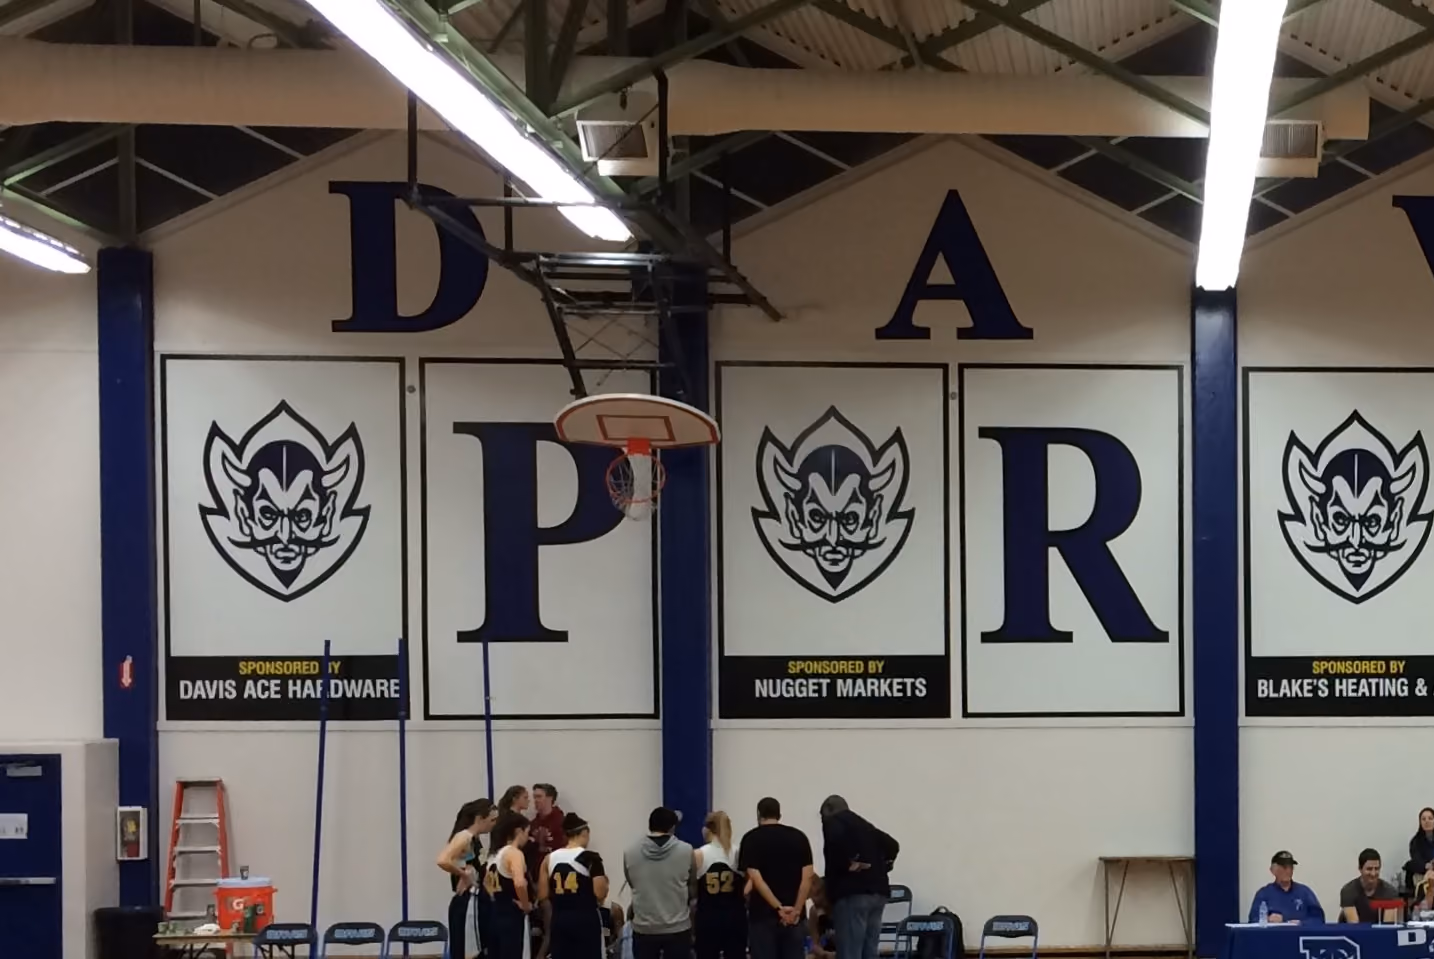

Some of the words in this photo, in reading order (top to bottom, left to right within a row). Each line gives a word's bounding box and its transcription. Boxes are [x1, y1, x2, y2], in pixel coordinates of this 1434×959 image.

[329, 181, 489, 332] D
[875, 189, 1033, 339] A
[453, 422, 630, 643] P
[978, 427, 1169, 643] R
[238, 661, 319, 675] SPONSORED
[788, 661, 864, 674] SPONSORED
[868, 660, 885, 673] BY
[1312, 661, 1386, 674] SPONSORED
[1390, 660, 1405, 673] BY
[179, 680, 237, 699] DAVIS
[243, 679, 281, 699] ACE
[755, 679, 830, 698] NUGGET
[836, 678, 927, 697] MARKETS
[1257, 679, 1329, 698] BLAKE'S
[1335, 678, 1408, 697] HEATING
[1414, 678, 1428, 697] &
[553, 872, 579, 894] 14
[706, 871, 734, 894] 52
